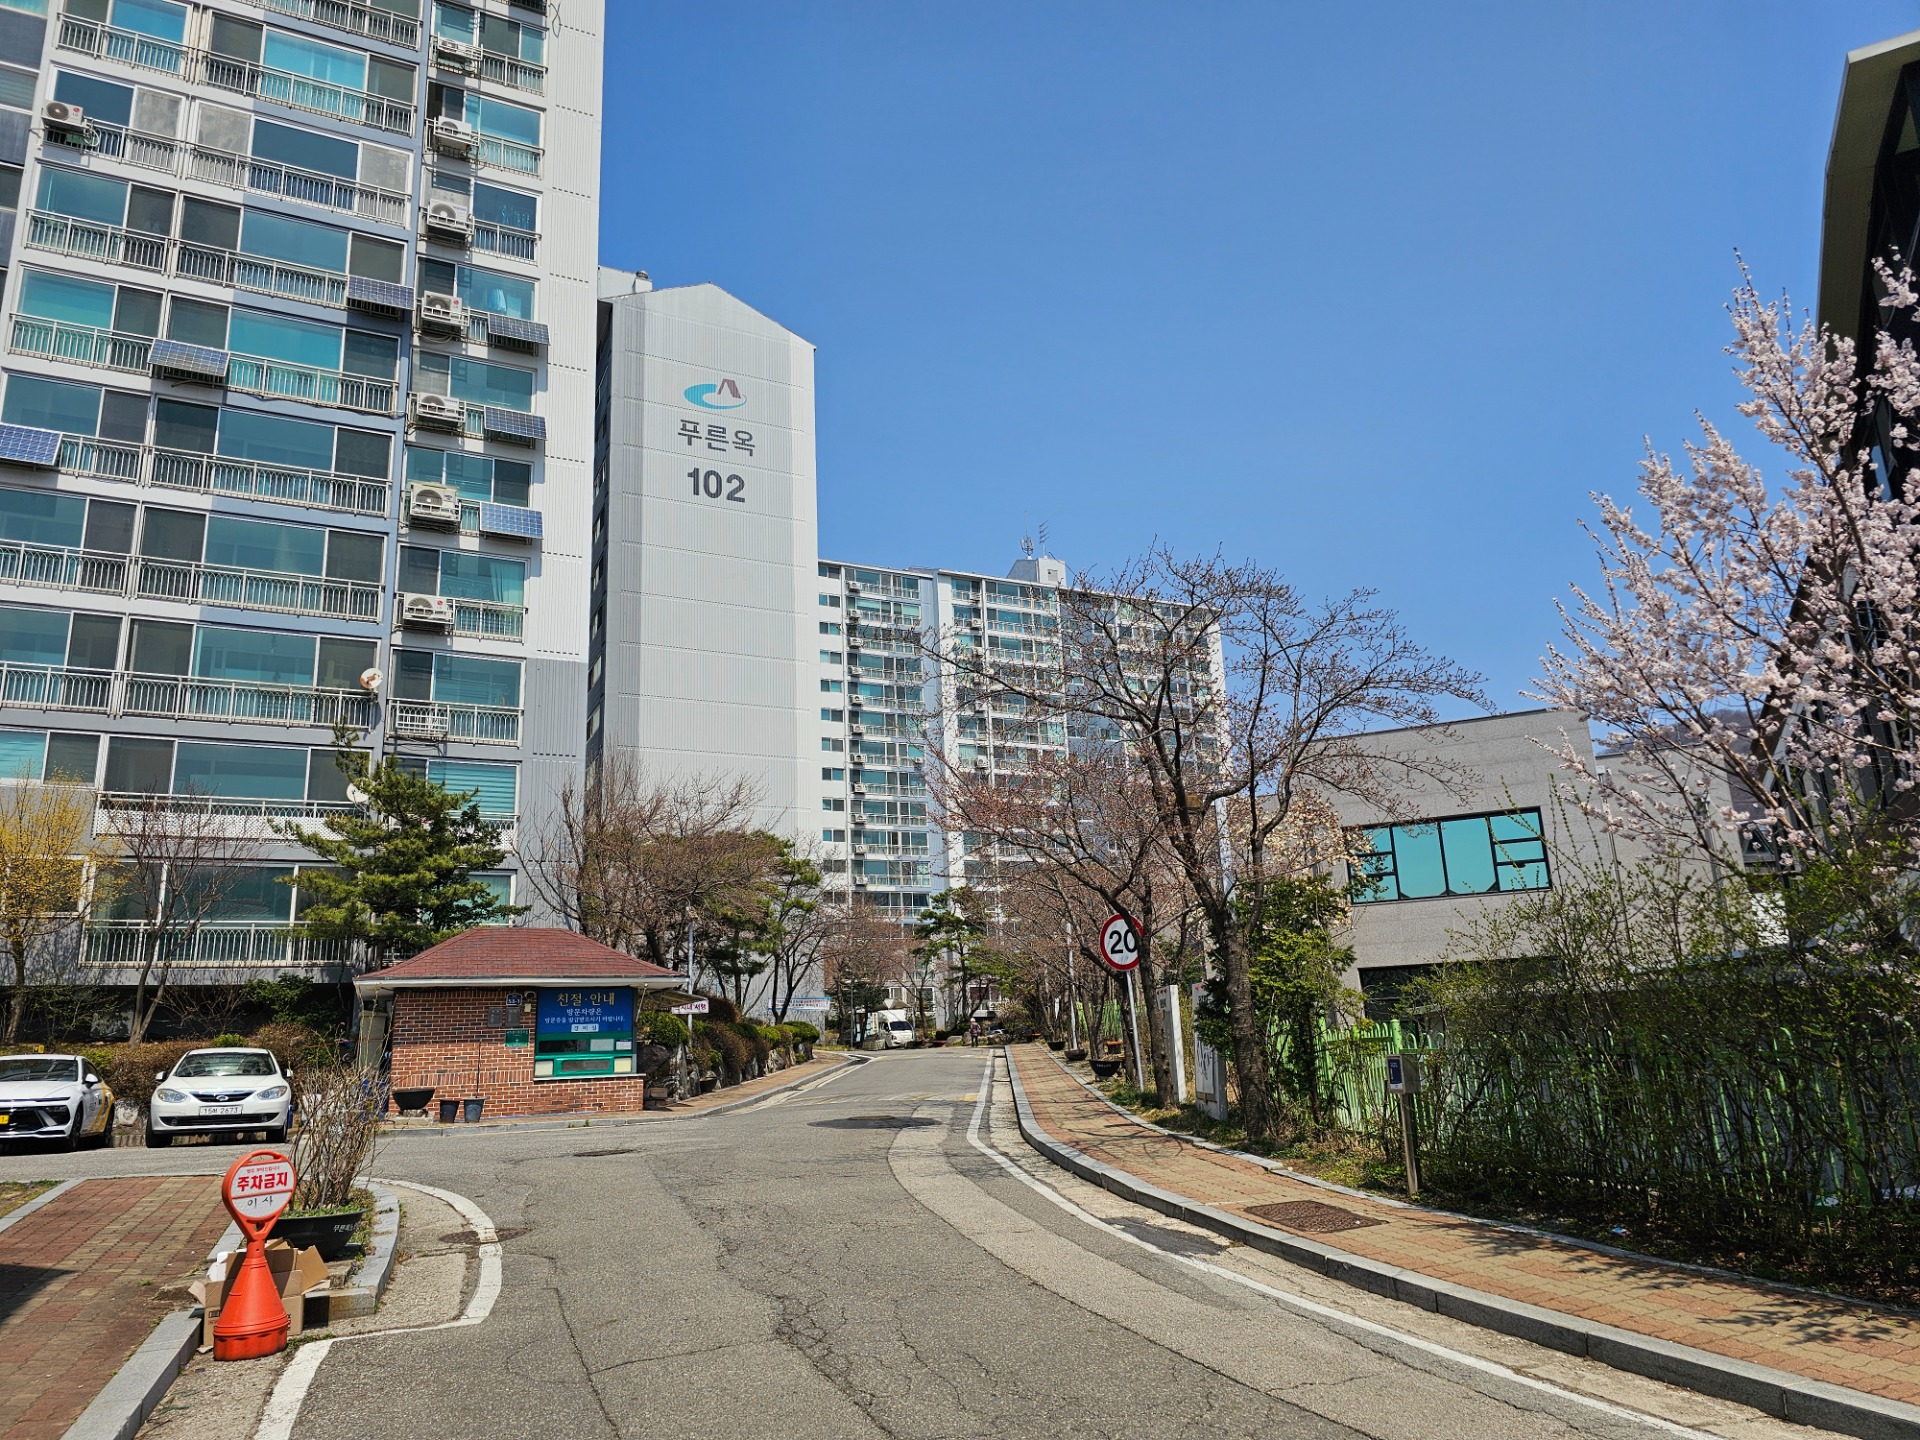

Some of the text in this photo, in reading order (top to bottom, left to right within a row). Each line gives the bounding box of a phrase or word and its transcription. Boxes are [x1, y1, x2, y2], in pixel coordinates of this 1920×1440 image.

[677, 419, 756, 457] 푸른옥
[687, 467, 746, 503] 102
[1109, 928, 1138, 955] 20
[556, 991, 616, 1007] 친절 안내
[566, 1007, 603, 1017] 방문차량은
[237, 1172, 288, 1192] 주차금지
[247, 1195, 274, 1209] 이사
